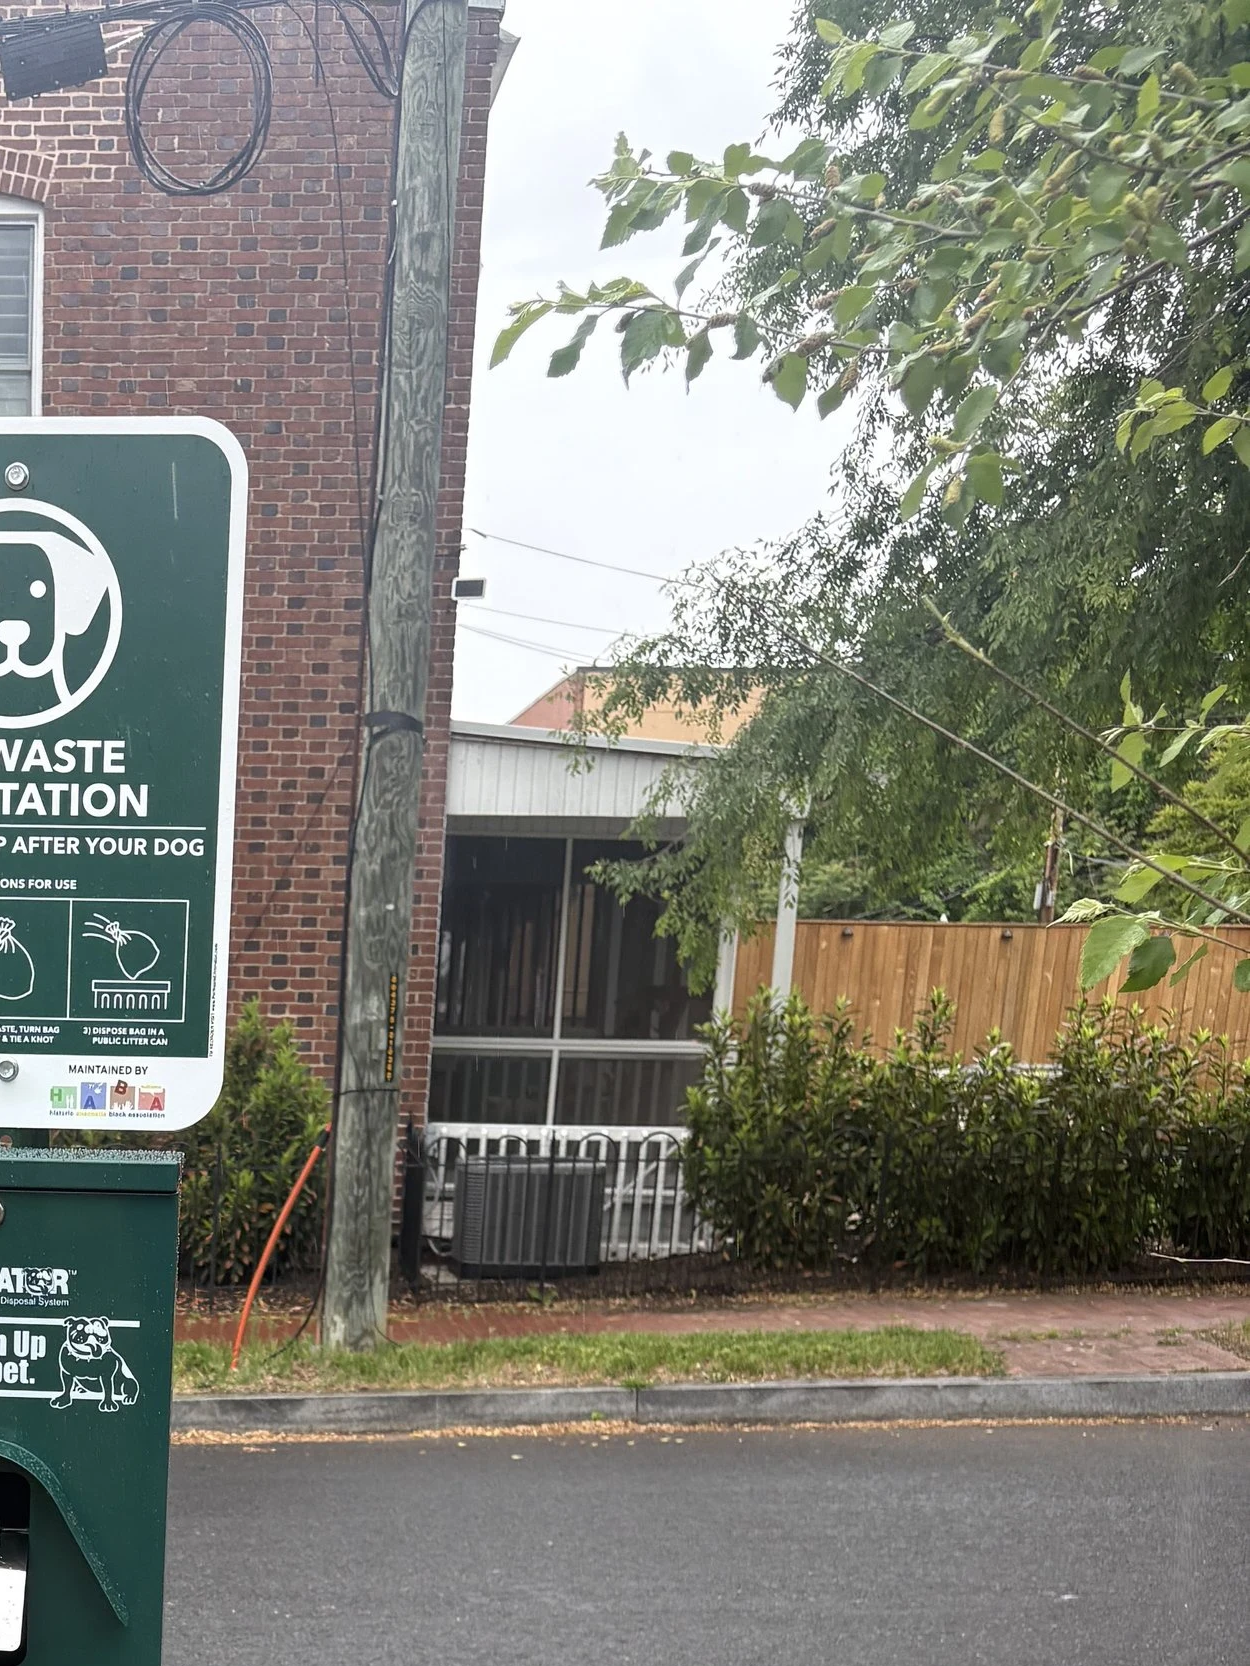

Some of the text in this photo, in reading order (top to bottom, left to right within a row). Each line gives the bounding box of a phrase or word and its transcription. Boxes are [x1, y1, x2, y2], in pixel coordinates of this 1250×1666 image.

[12, 836, 79, 854] AFTER
[85, 837, 147, 855] YOUR
[154, 838, 204, 856] DOG
[28, 879, 51, 889] FOR
[55, 880, 76, 889] USE
[19, 1025, 42, 1033] TURN
[42, 1026, 60, 1034] BAG
[92, 1027, 127, 1035] DISPOSE
[129, 1027, 146, 1035] BAG
[148, 1028, 157, 1036] IN
[158, 1028, 165, 1036] A
[2, 1035, 8, 1043] &
[9, 1035, 23, 1043] TIE
[23, 1035, 30, 1043] A
[31, 1035, 55, 1043] KNOT
[92, 1037, 121, 1045] PUBLIC
[150, 1038, 168, 1046] CAN
[69, 1065, 148, 1075] MAINTAINED BY
[50, 1080, 162, 1110] H A B A
[0, 1297, 36, 1307] Disposal
[38, 1298, 69, 1307] System
[13, 1331, 47, 1360] Up
